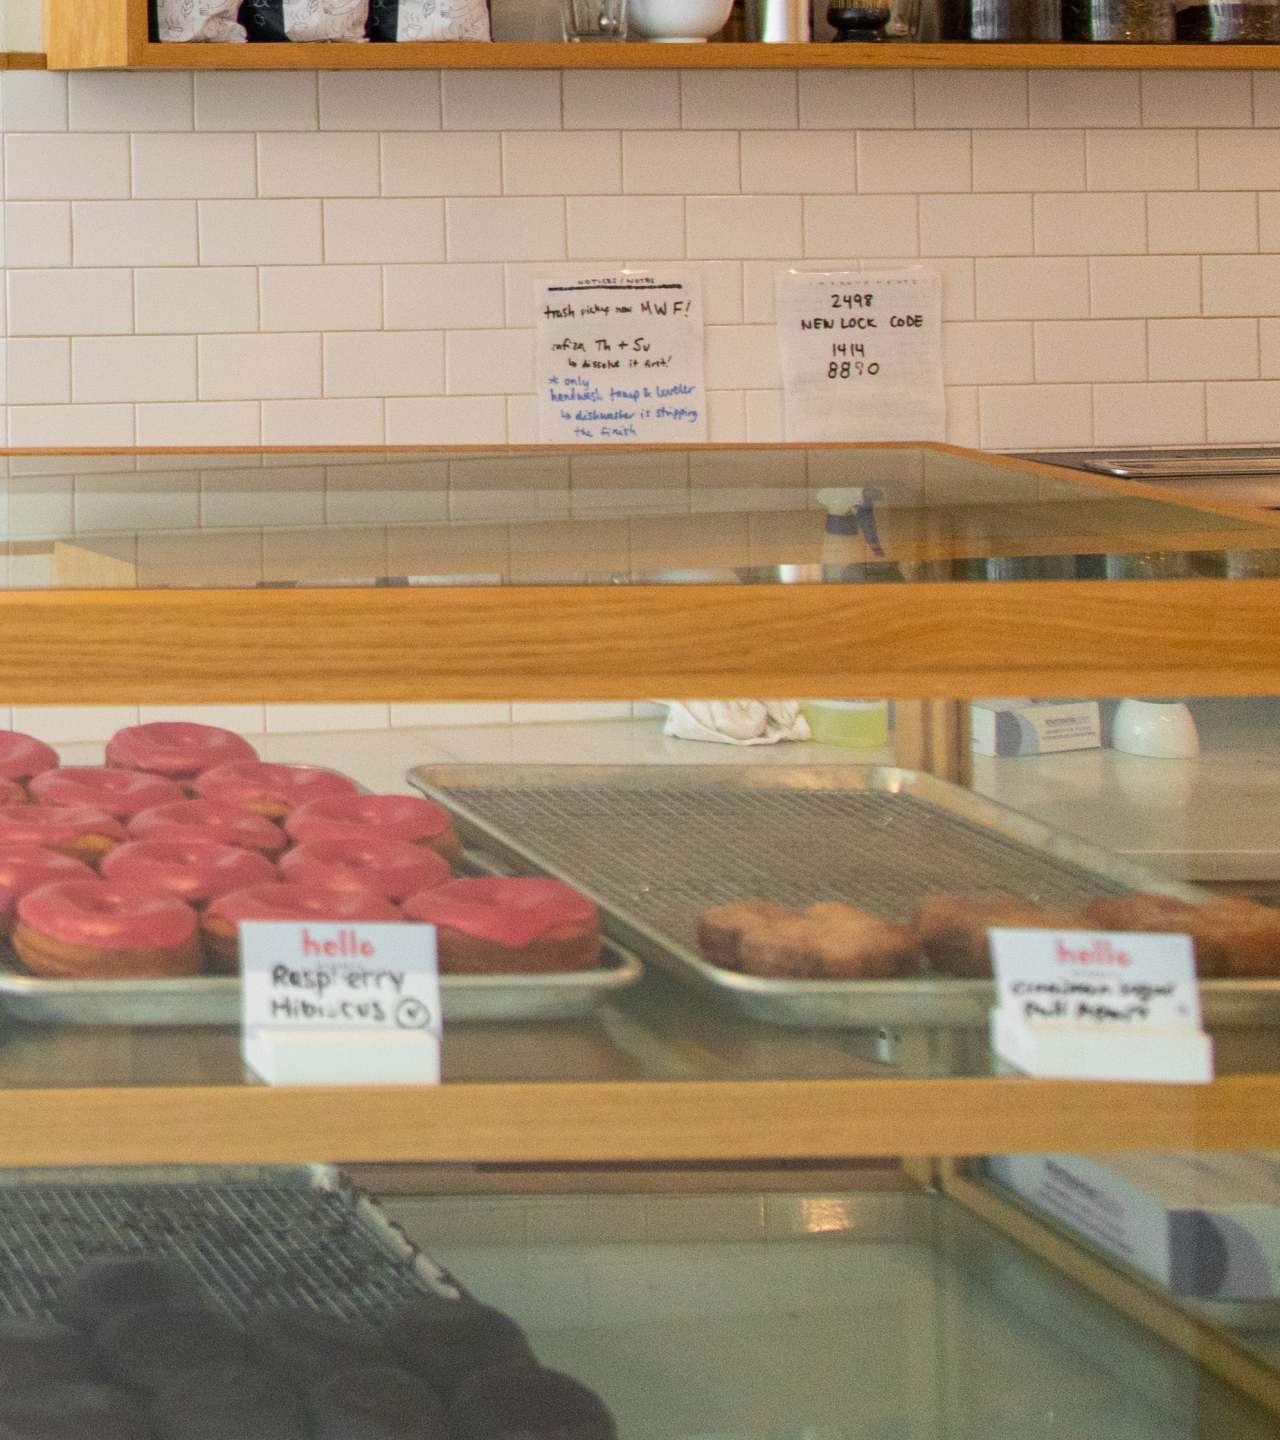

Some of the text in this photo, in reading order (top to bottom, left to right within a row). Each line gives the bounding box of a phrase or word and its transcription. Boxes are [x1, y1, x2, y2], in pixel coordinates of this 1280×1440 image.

[831, 293, 874, 309] 2498
[840, 317, 878, 330] LOCK
[889, 315, 924, 328] CODE
[301, 929, 377, 959] hello
[271, 962, 405, 995] Rasperry
[271, 996, 387, 1022] Hibicus
